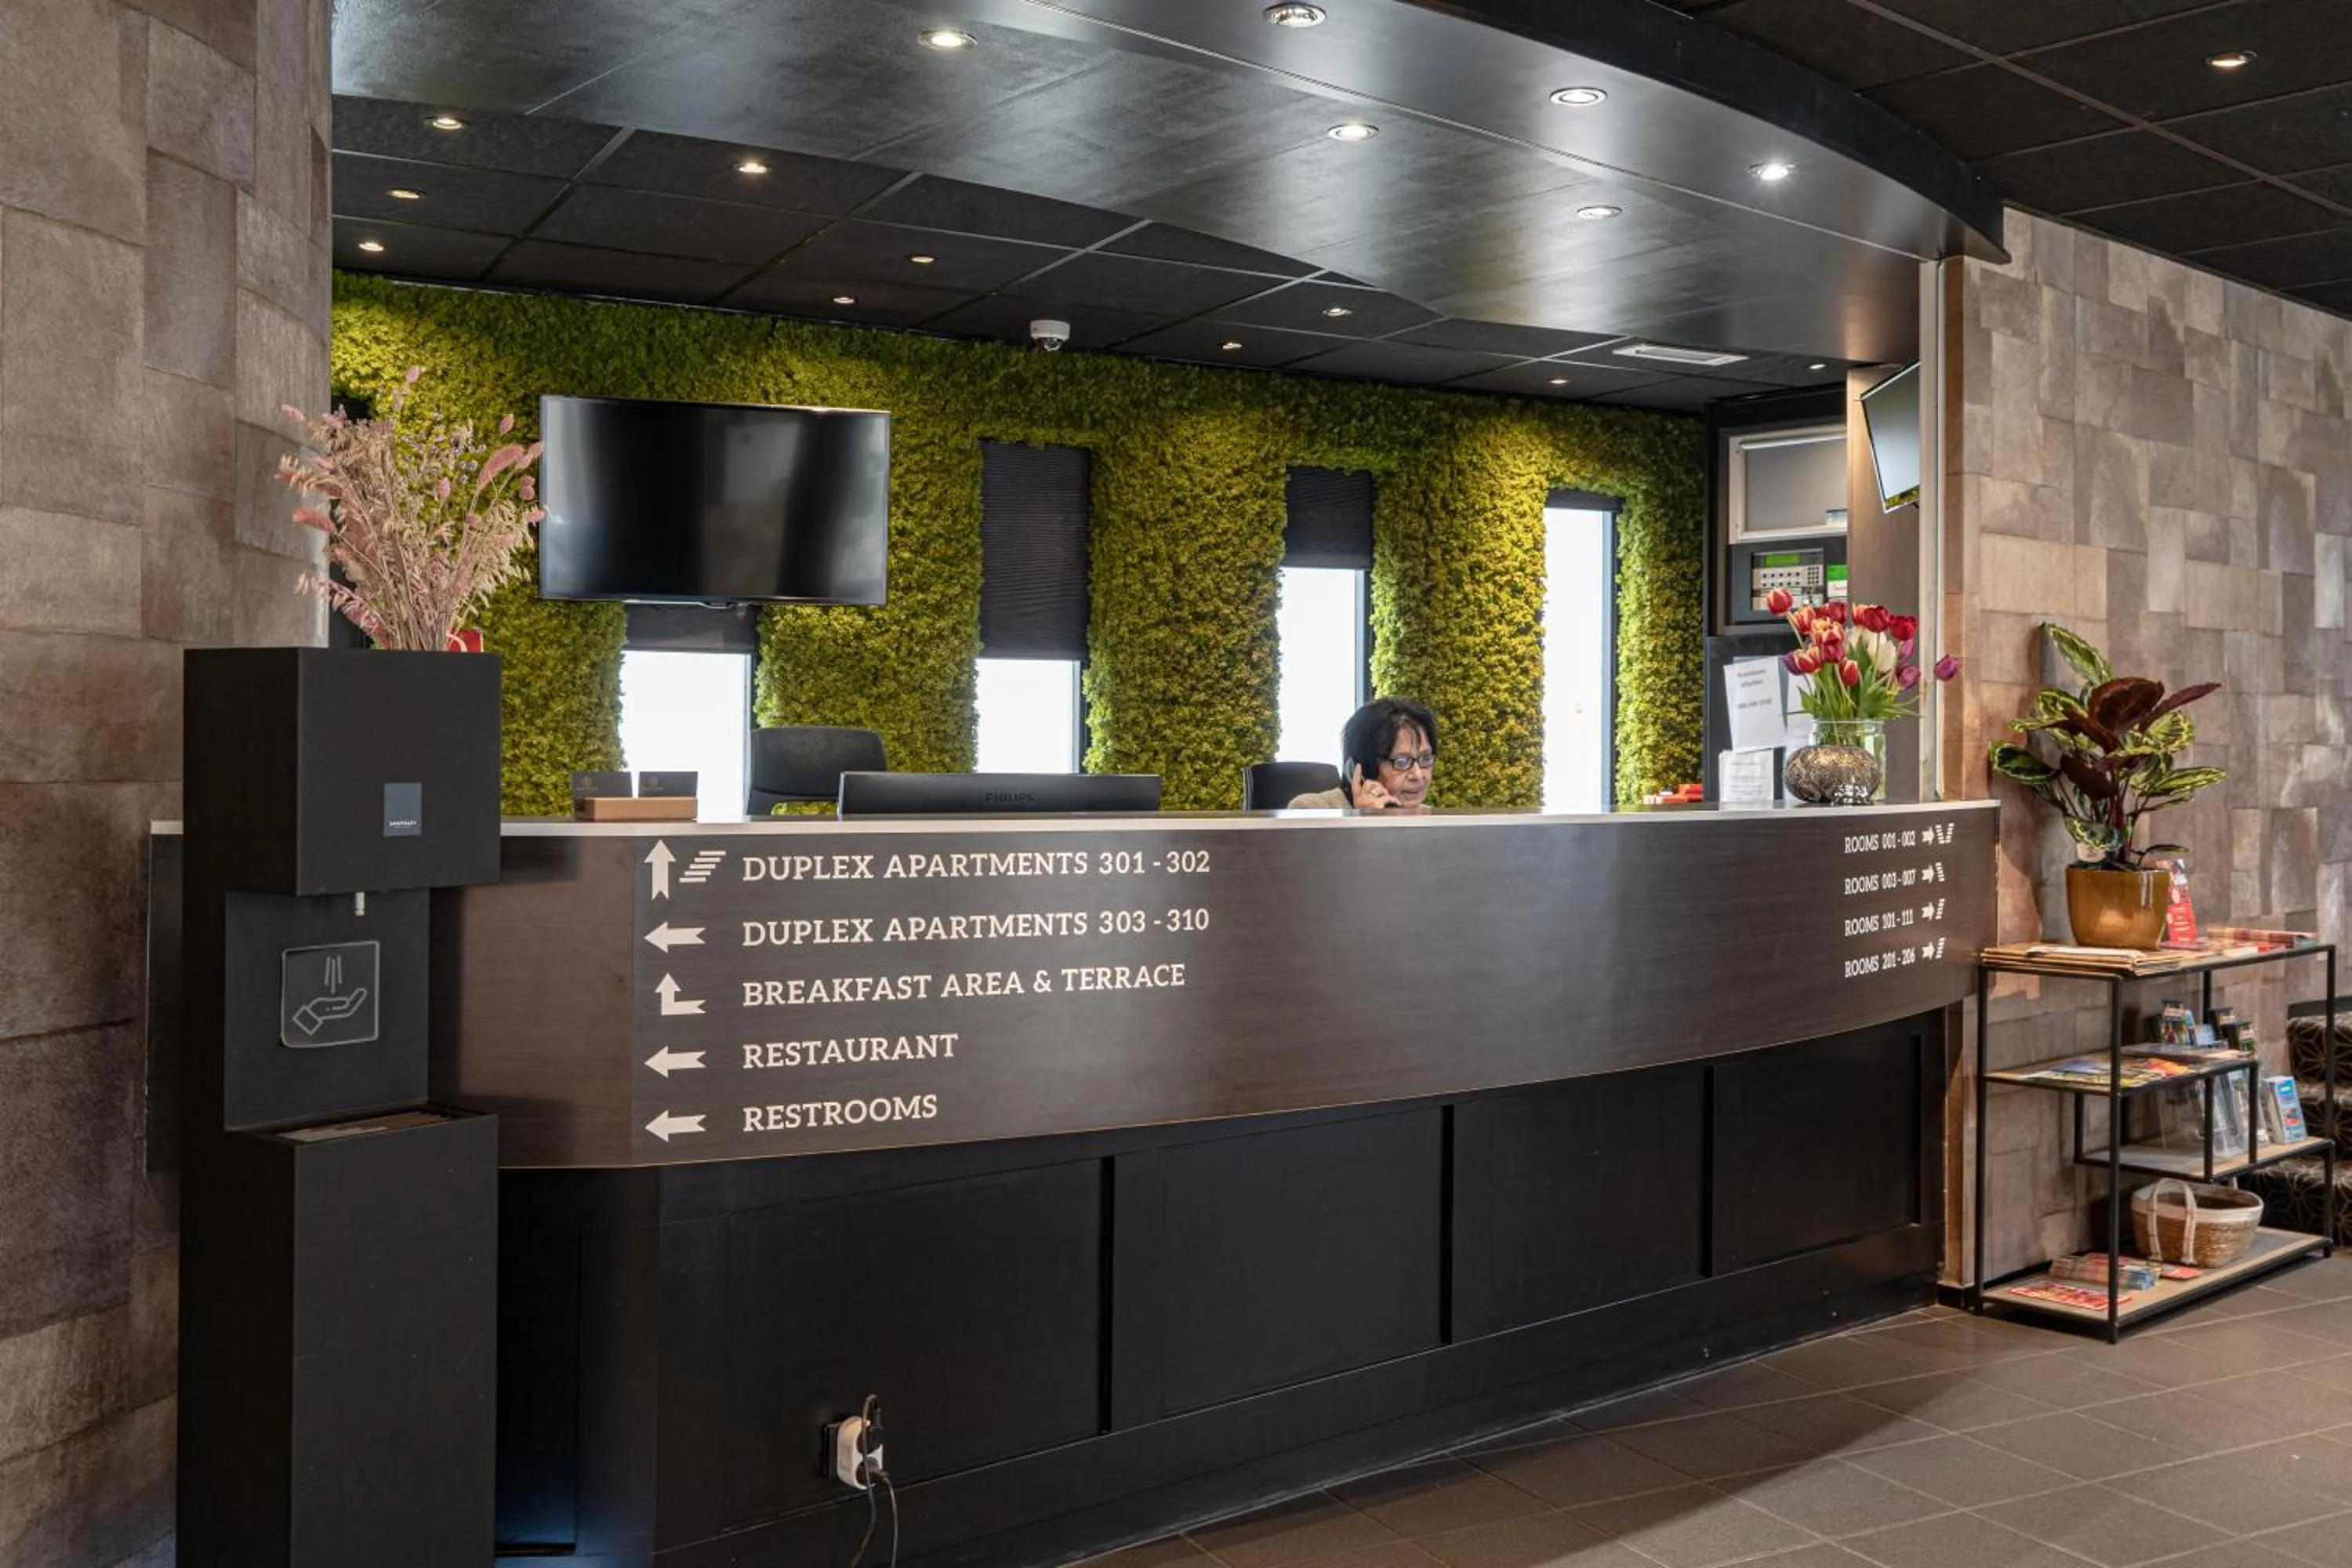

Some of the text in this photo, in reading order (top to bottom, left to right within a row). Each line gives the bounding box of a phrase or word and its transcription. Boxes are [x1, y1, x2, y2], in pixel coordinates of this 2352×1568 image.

[1844, 833, 1879, 854] ROOMS
[742, 855, 874, 881] DUPLEX
[883, 851, 1089, 879] APARTMENTS
[1098, 851, 1145, 875] 301
[1166, 850, 1210, 873] 302
[1844, 873, 1879, 895] ROOMS
[742, 917, 874, 946] DUPLEX
[882, 912, 1088, 942] APARTMENTS
[1098, 909, 1146, 935] 303
[1166, 908, 1210, 932] 310
[1844, 914, 1879, 937] ROOMS
[1844, 954, 1880, 978] ROOMS
[742, 964, 1185, 1007] BREAKFAST AREA & TERRACE
[742, 1033, 959, 1069] RESTAURANT
[742, 1094, 938, 1132] RESTROOMS
